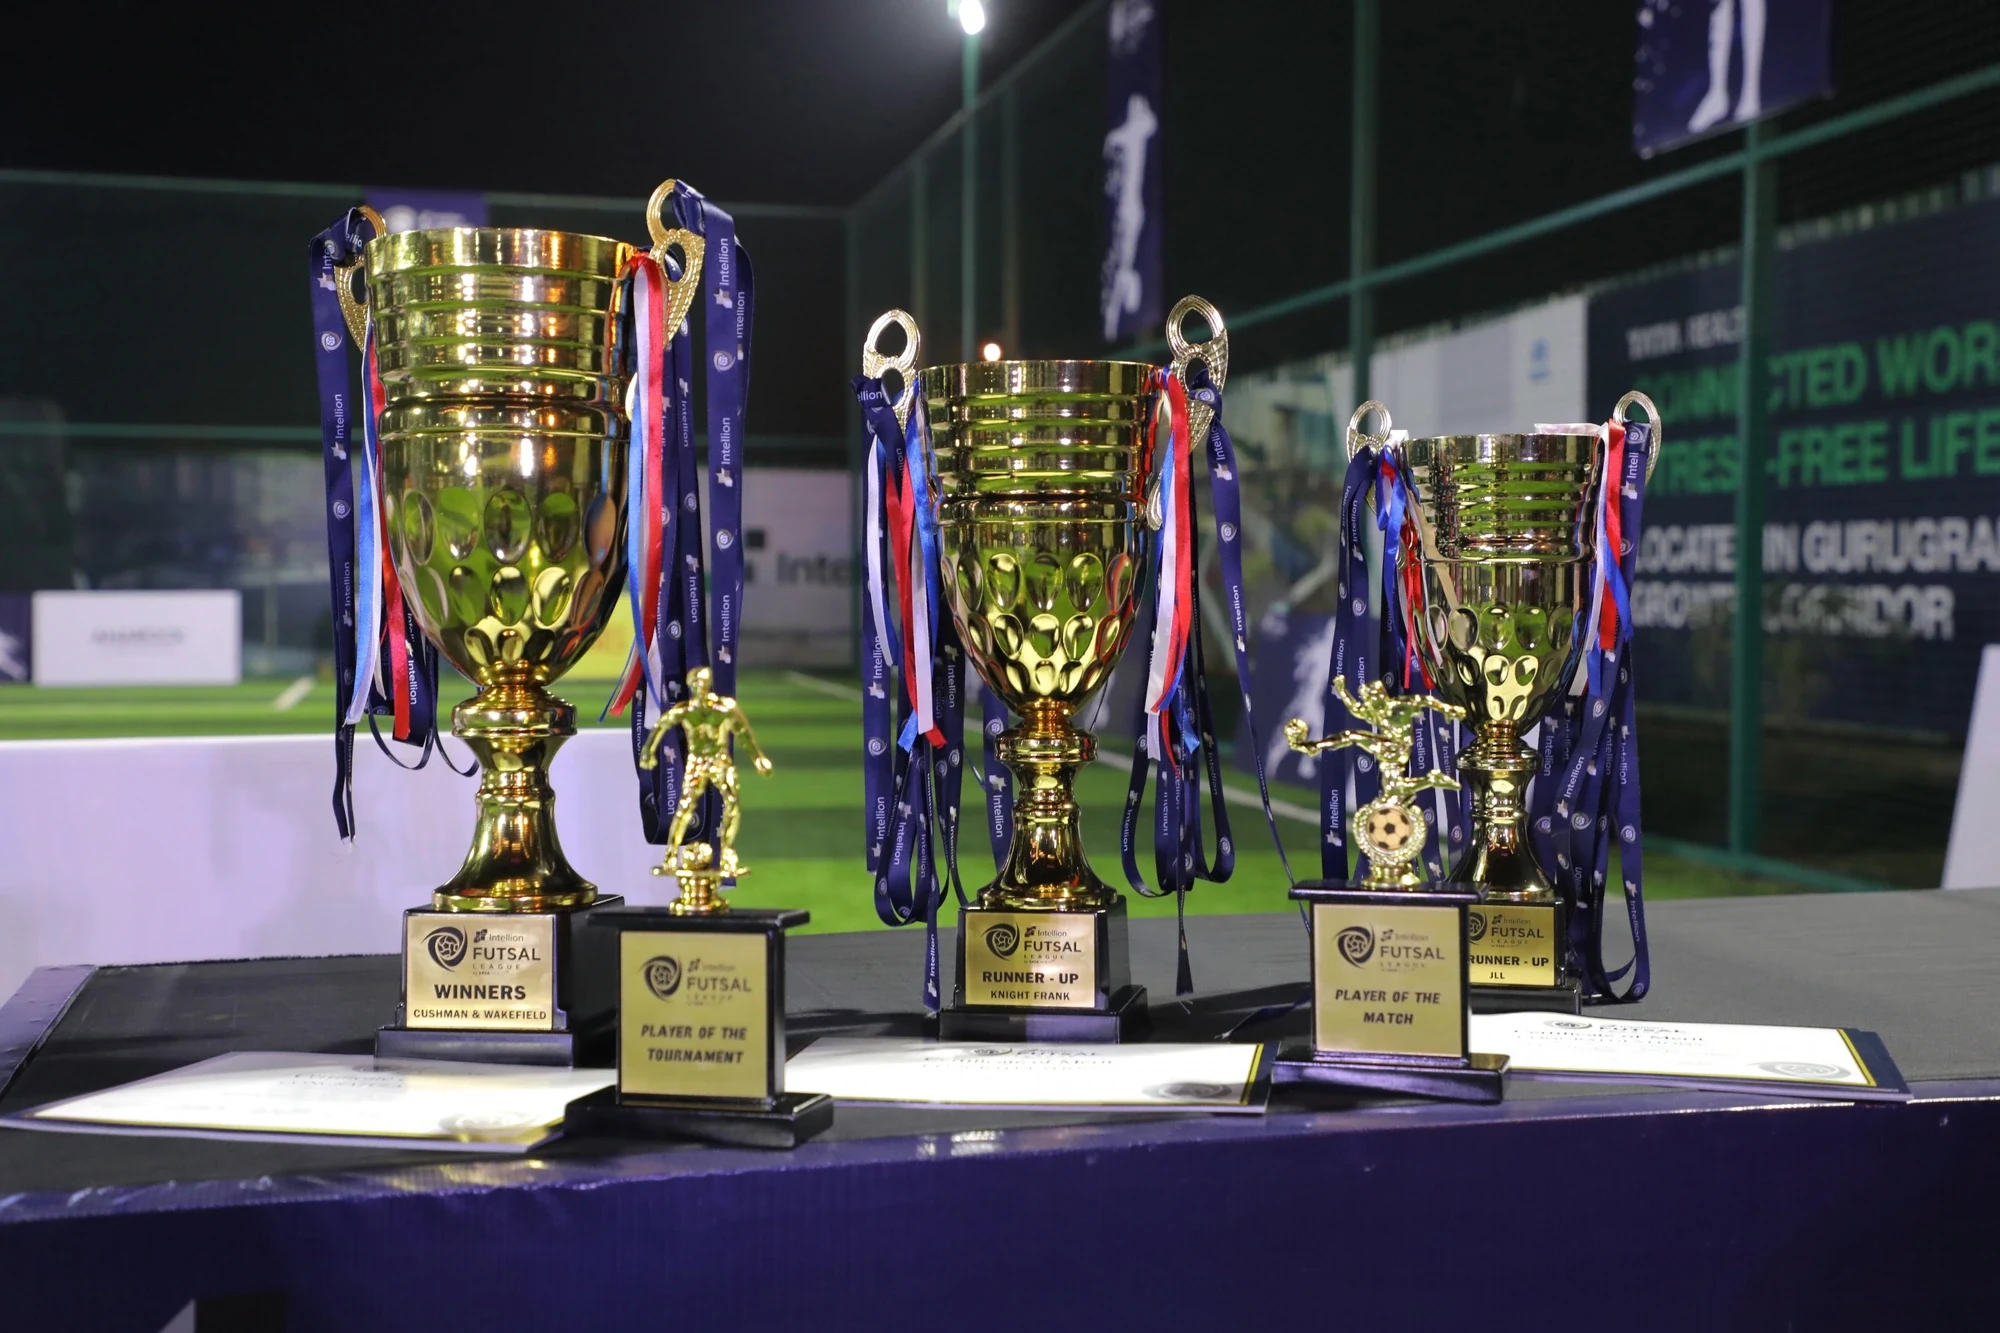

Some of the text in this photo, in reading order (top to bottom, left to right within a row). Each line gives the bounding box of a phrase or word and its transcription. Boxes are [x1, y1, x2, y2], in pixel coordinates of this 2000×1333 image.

[719, 238, 730, 286] Intellion
[334, 394, 345, 439] Intellion
[857, 390, 883, 401] ellion
[720, 417, 731, 465] Intellion
[1211, 425, 1225, 461] Intellio
[1901, 406, 2000, 479] LIFE
[1626, 452, 1638, 479] Intell
[1761, 522, 1799, 573] IN
[1802, 515, 2000, 574] GURUGRA
[689, 576, 699, 623] Intellion
[721, 595, 730, 642] Intellion
[1232, 585, 1243, 631] Intellion
[873, 636, 883, 679] Intellion
[1336, 639, 1345, 676] ntellion
[408, 660, 418, 705] Intellion
[947, 665, 956, 708] Intellion
[1415, 728, 1425, 770] Intellion
[1544, 735, 1554, 777] Intellion
[1605, 733, 1613, 776] Intellion
[1619, 742, 1628, 785] Intellion
[666, 768, 677, 815] Intellion
[1564, 756, 1585, 798] Intellion
[876, 796, 885, 840] Intellion
[993, 794, 1004, 838] Intellion
[1123, 808, 1133, 852] Intellion
[1330, 789, 1339, 829] Intellion
[894, 822, 906, 865] Intellion
[489, 933, 524, 942] Intellion
[1491, 927, 1544, 938] FUTSAL
[1630, 900, 1640, 942] Intellion
[473, 947, 541, 961] FUTSAL
[1024, 941, 1081, 953] FUTSAL
[1380, 945, 1445, 960] FUTSAL
[1469, 955, 1520, 966] RUNNER
[1532, 957, 1549, 967] UP
[434, 984, 526, 1000] WINNERS
[686, 977, 752, 992] FUTSAL
[982, 971, 1044, 983] RUNNER
[1059, 973, 1079, 984] UP
[991, 990, 1070, 1001] KNIGHT FRANK
[1489, 971, 1505, 979] JLL
[413, 1009, 547, 1020] CUSHMAN & WAKEFIELD
[1335, 989, 1441, 1004] PLAYER OF THE
[641, 1024, 747, 1040] PLAYER OF THE
[1363, 1012, 1414, 1025] MATCH
[648, 1048, 744, 1064] TOURNAMENT
